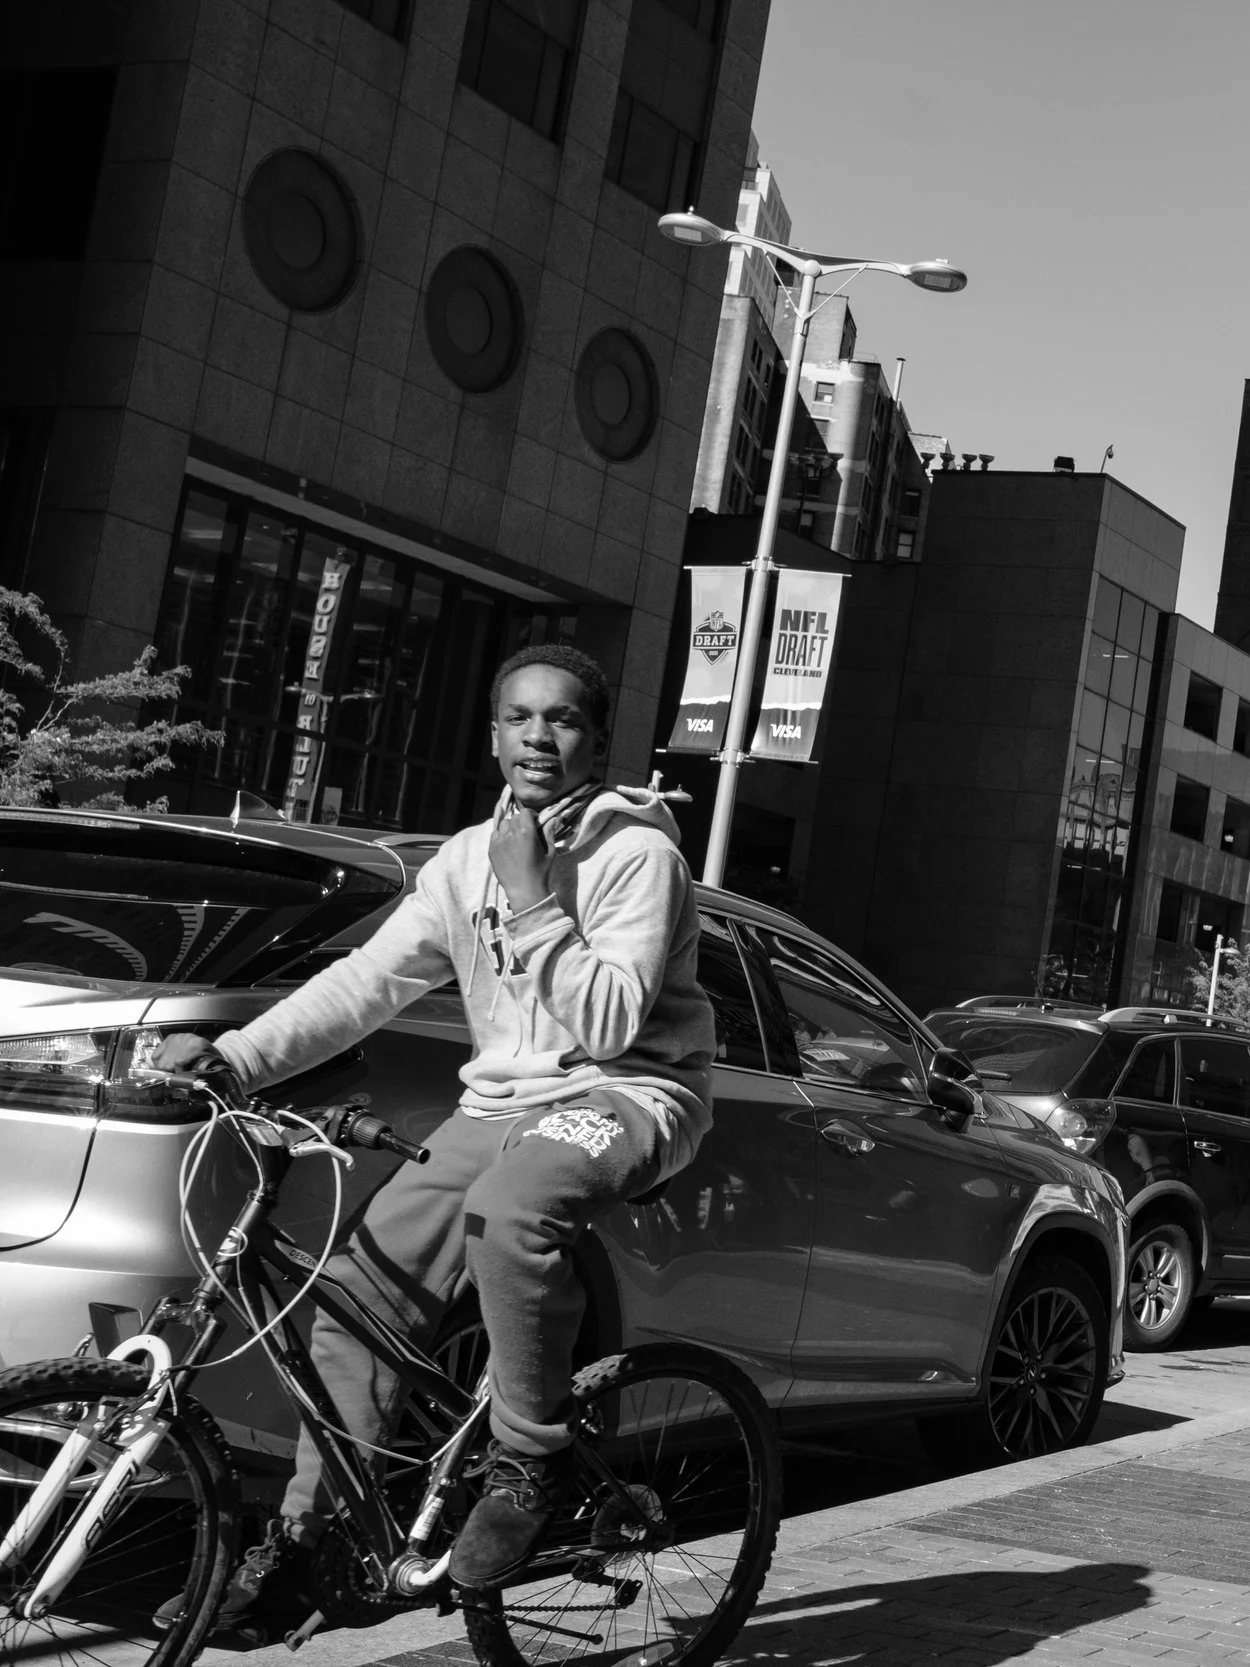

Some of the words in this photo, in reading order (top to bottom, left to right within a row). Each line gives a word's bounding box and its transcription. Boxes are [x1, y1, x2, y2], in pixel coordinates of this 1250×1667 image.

[779, 609, 829, 634] NFL
[695, 635, 735, 646] DRAFT
[775, 633, 828, 668] DRAFT
[773, 667, 822, 678] CLEVELAND
[686, 718, 713, 732] VISA
[770, 723, 801, 739] VISA
[289, 1250, 317, 1268] DESCEN
